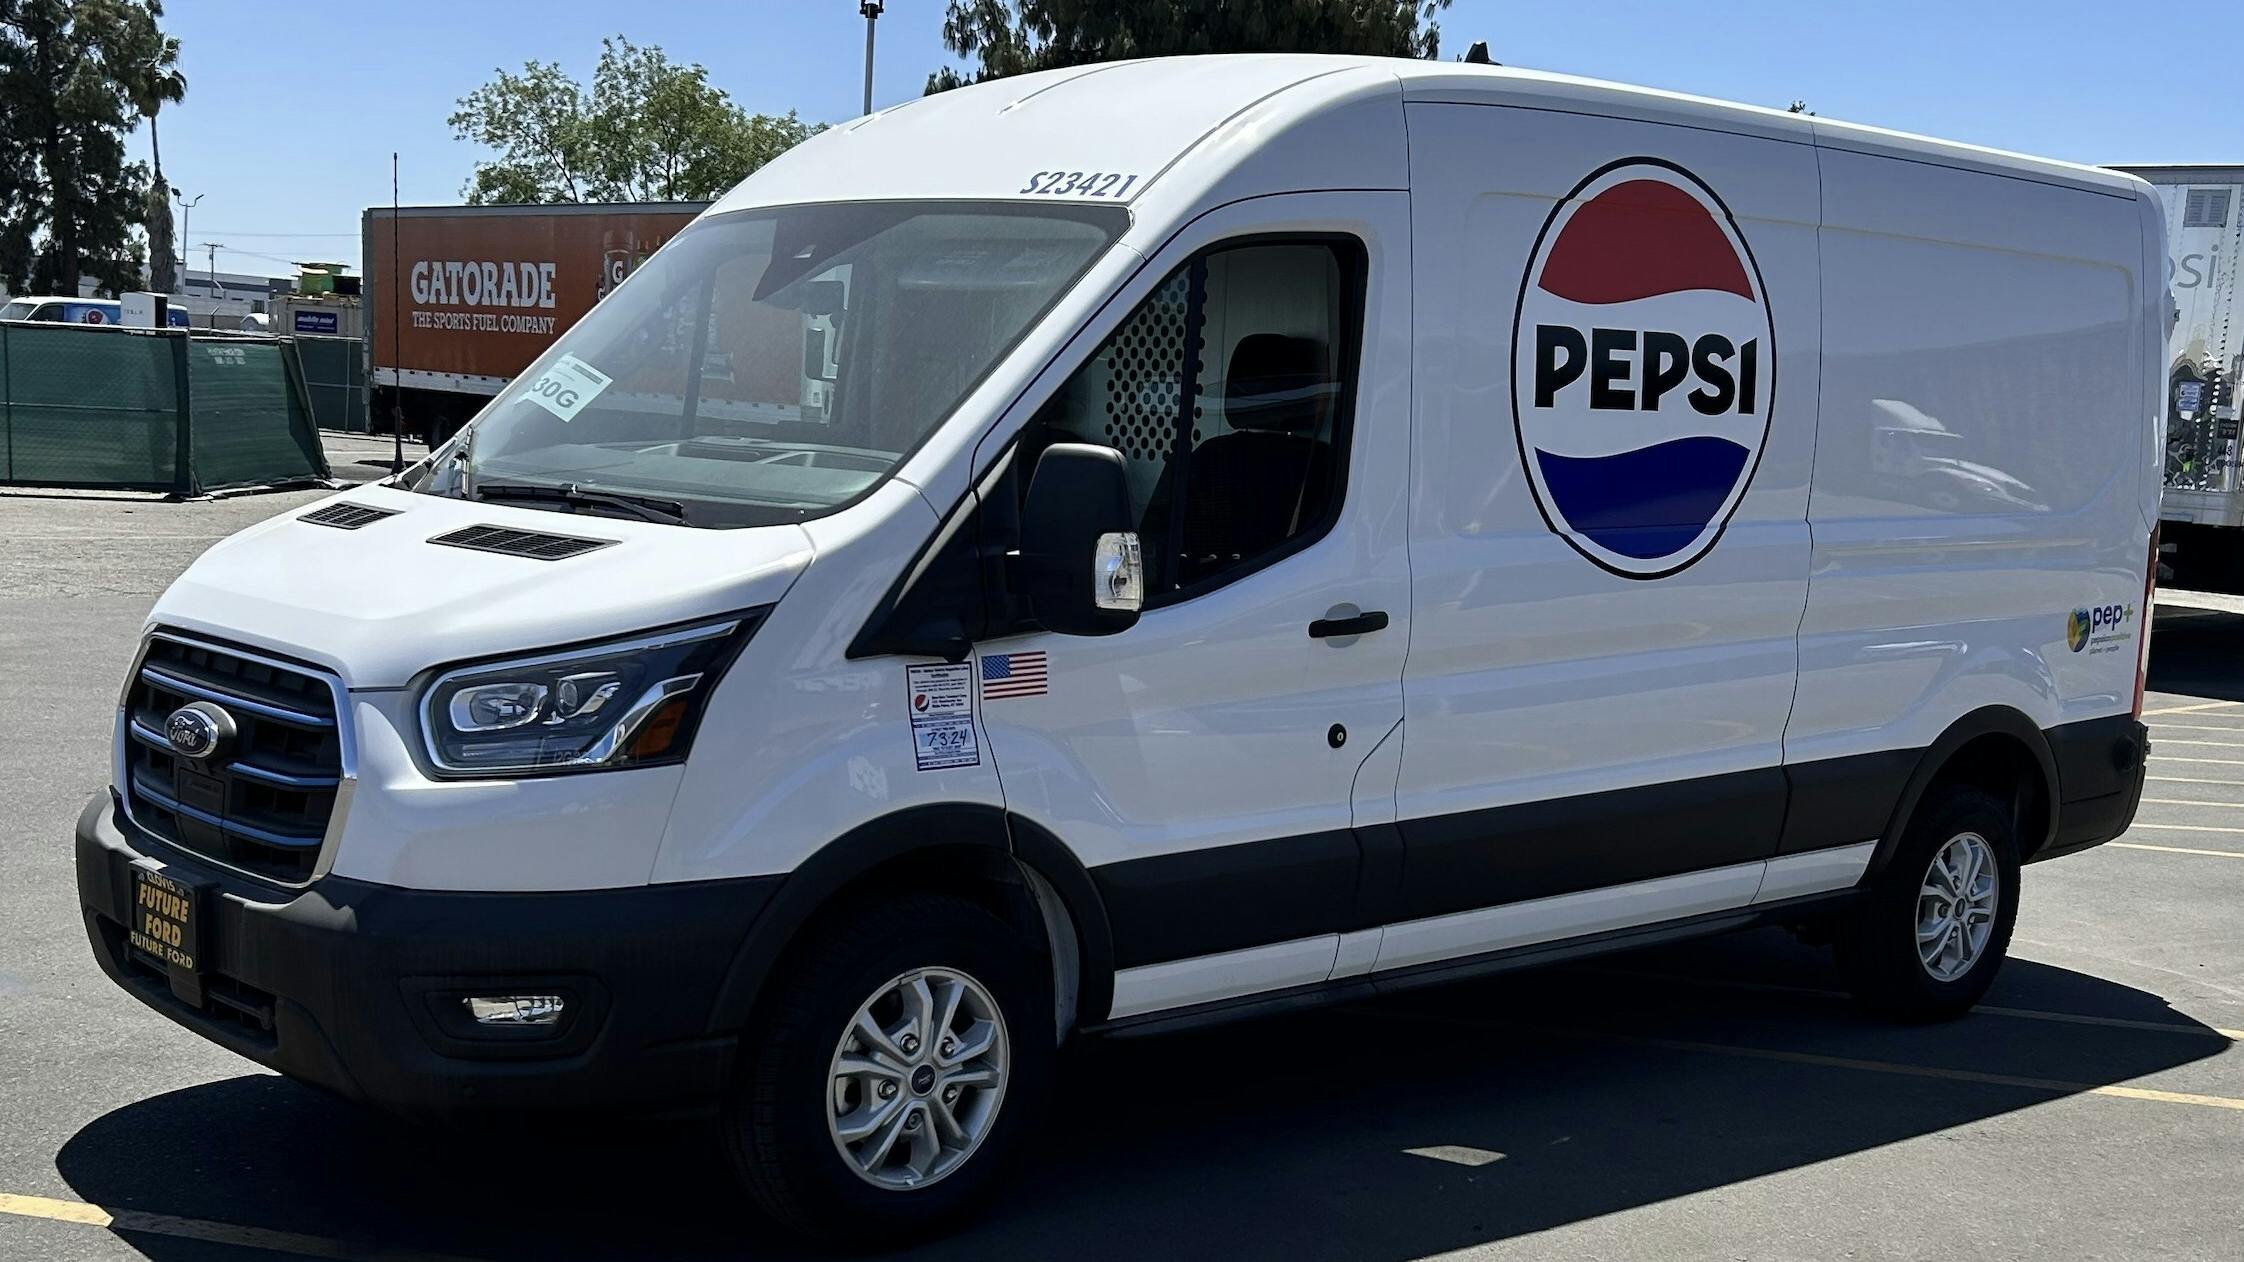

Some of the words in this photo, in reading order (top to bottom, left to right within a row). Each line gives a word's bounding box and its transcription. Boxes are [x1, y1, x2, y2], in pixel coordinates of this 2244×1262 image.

[1019, 171, 1138, 198] S23421
[411, 260, 556, 308] GATORADE
[2169, 244, 2219, 289] si
[412, 311, 432, 328] THE
[434, 312, 471, 330] SPORTS
[473, 314, 499, 331] FUEL
[501, 315, 556, 335] COMPANY
[1535, 324, 1758, 416] PEPSI
[169, 715, 201, 747] Ford
[138, 882, 190, 923] FUTURE
[130, 930, 164, 957] FUTURE
[167, 947, 194, 969] FORD
[145, 912, 182, 948] FORD
